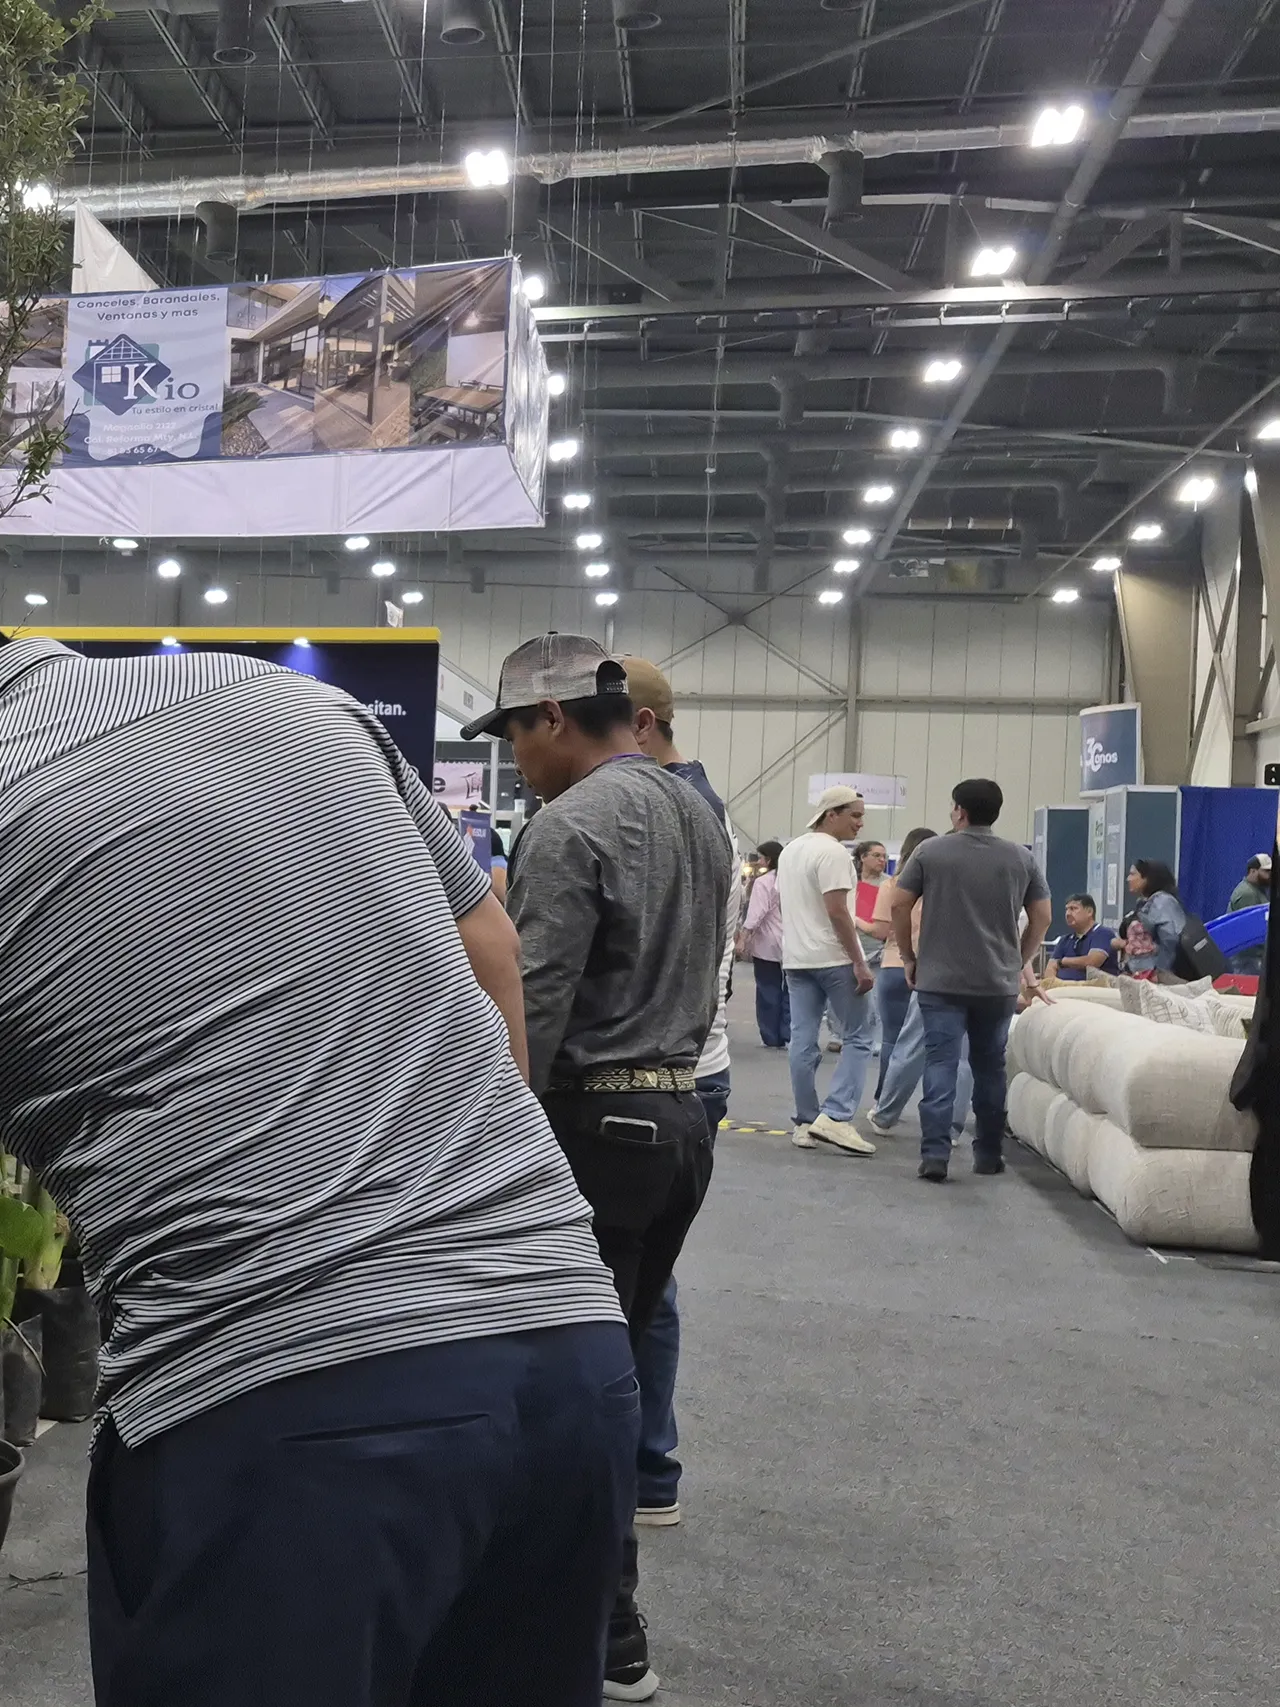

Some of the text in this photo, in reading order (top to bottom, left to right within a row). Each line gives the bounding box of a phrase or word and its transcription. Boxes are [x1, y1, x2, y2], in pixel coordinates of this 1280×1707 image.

[97, 308, 198, 321] Ventanas y mas
[123, 362, 200, 400] Kio
[132, 403, 219, 415] Tu estilo en cristal
